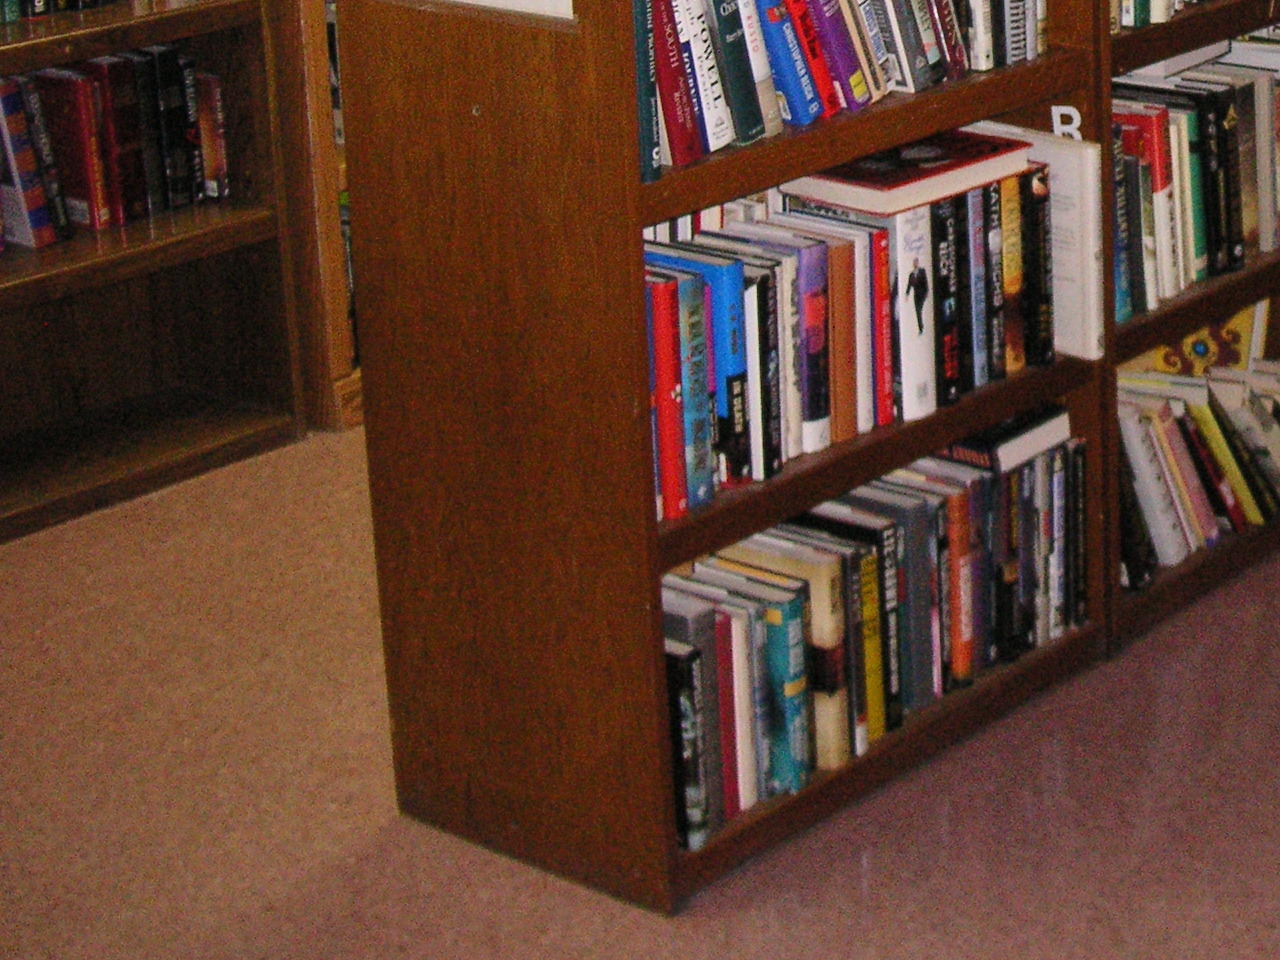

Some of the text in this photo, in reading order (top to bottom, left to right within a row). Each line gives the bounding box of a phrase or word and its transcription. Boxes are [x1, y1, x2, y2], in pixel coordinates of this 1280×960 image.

[662, 23, 679, 69] SOUTH
[746, 14, 760, 53] RUSSO
[782, 22, 806, 72] CHRISTOPHER
[695, 13, 725, 110] POWELL
